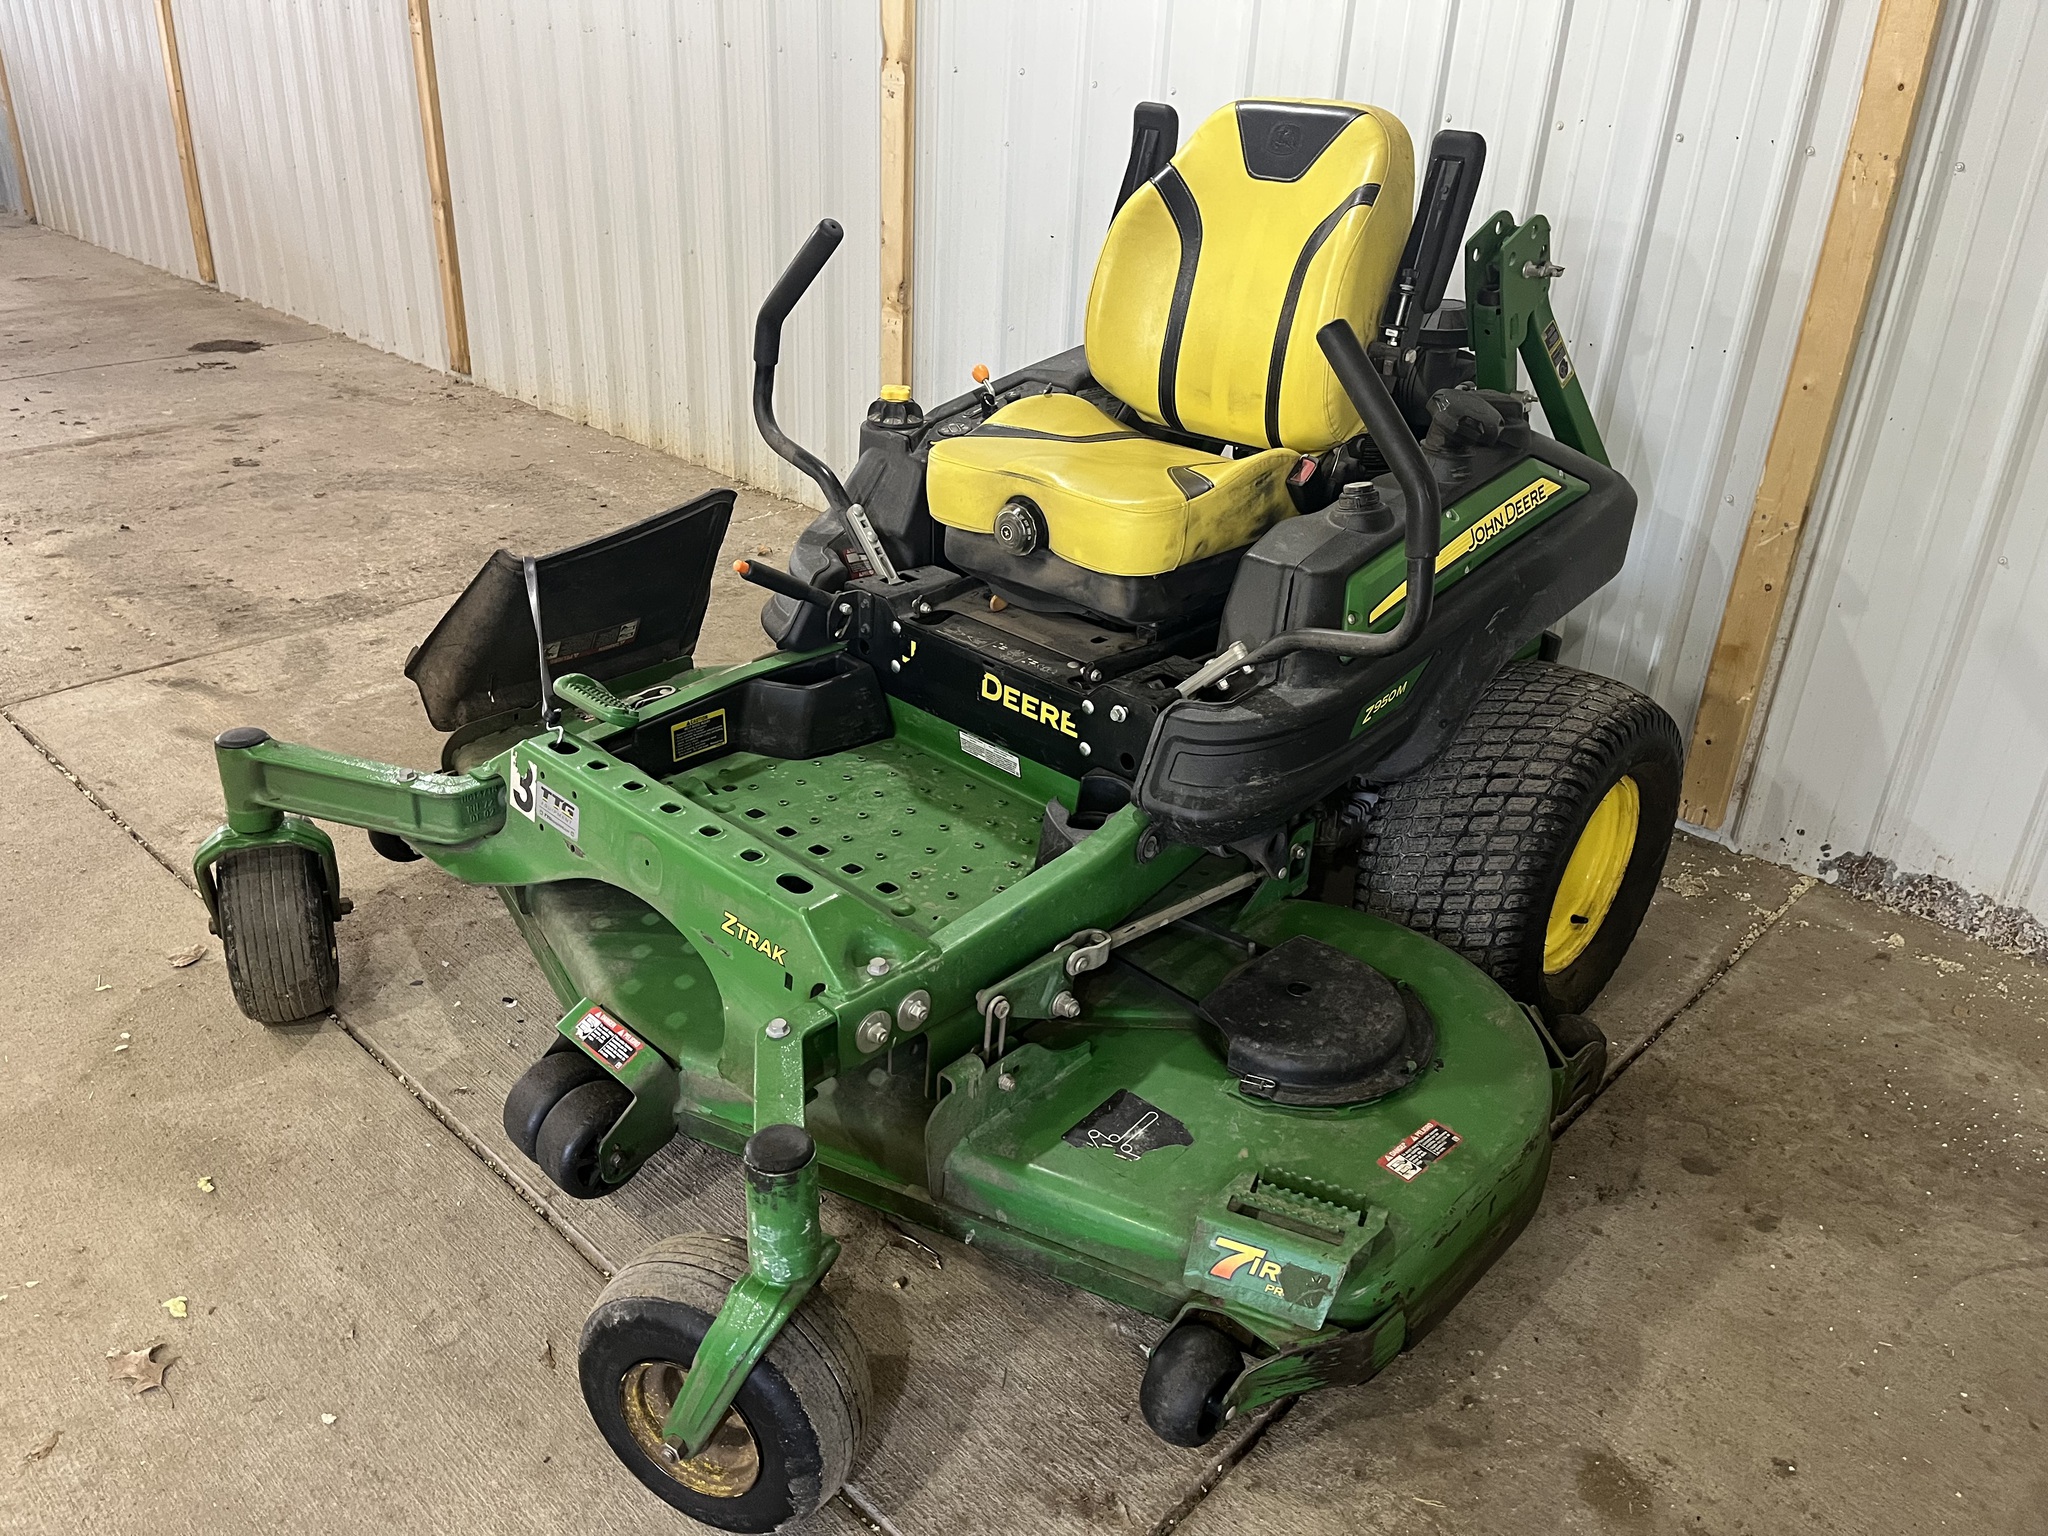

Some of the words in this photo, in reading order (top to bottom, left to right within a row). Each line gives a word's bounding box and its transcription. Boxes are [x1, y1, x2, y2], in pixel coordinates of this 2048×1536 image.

[1468, 513, 1504, 550] JOHN
[1504, 484, 1547, 524] DEERE
[981, 671, 1079, 739] DEERE
[1361, 680, 1408, 725] Z950M
[540, 786, 575, 817] TTG
[720, 910, 788, 968] ZTRAK
[1264, 1283, 1285, 1299] PR
